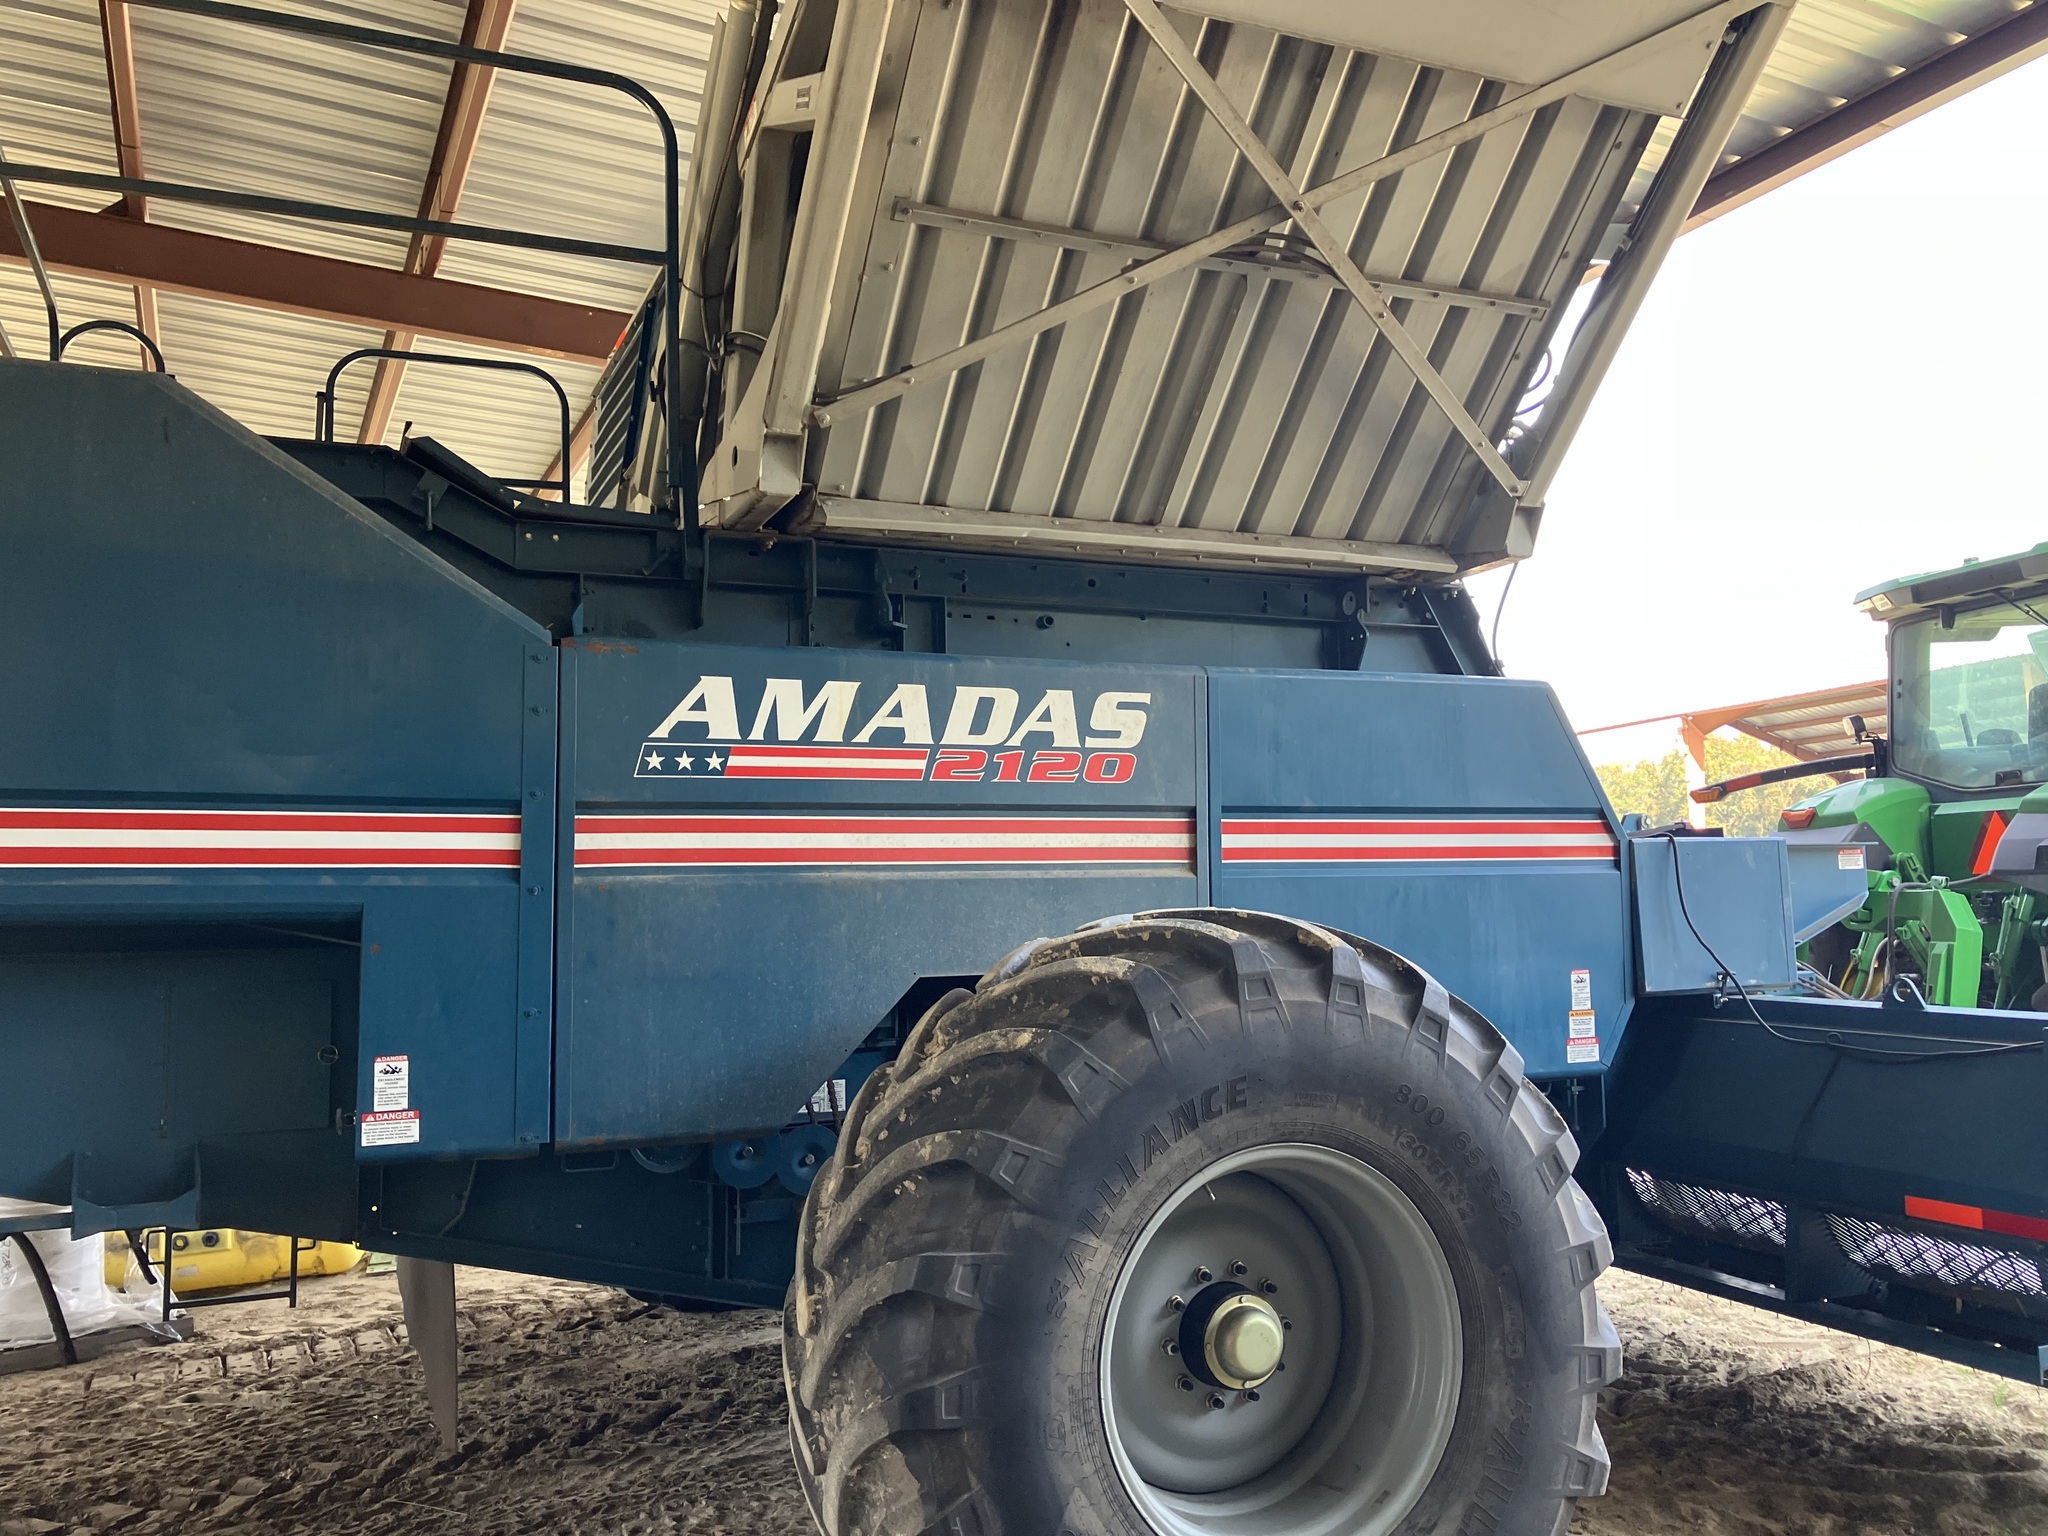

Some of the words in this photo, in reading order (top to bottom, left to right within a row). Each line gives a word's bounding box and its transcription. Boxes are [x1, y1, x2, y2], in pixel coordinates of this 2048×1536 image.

[648, 675, 1152, 748] AMADAS
[929, 749, 1137, 784] 2120
[376, 1111, 415, 1121] DANGER
[1061, 1073, 1249, 1290] ALLIANCE
